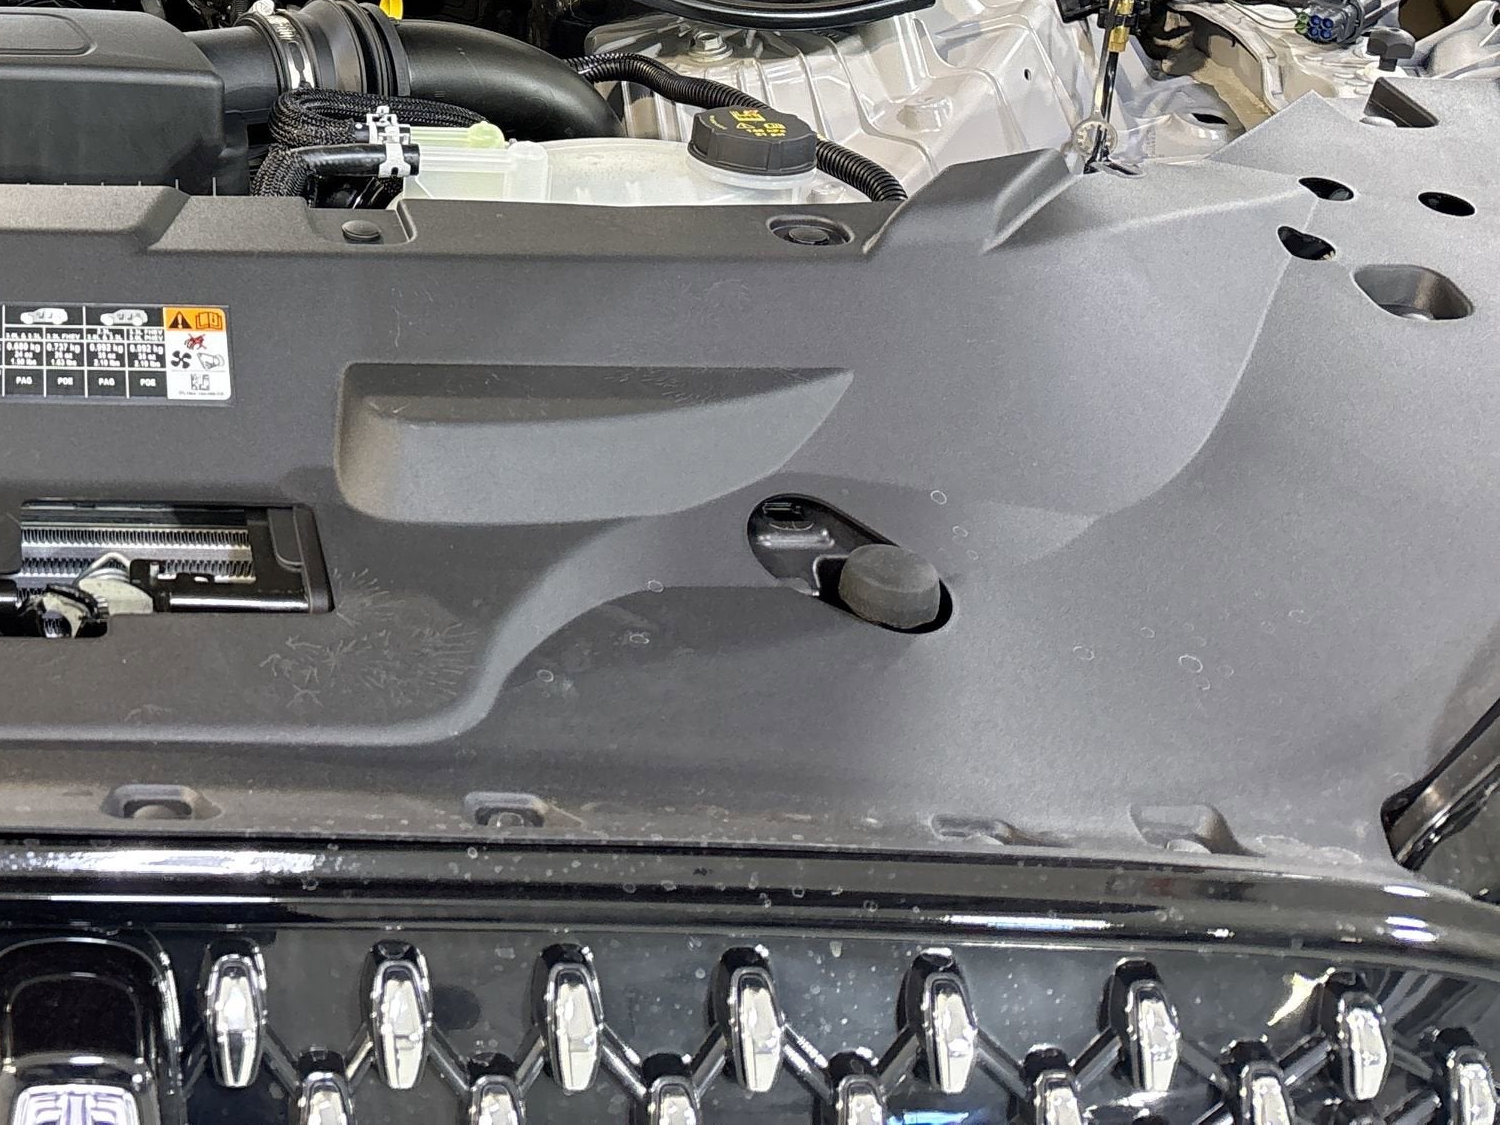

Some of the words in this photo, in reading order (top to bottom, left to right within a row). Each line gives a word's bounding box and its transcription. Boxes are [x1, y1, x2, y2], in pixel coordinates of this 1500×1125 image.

[6, 342, 28, 351] 0.680
[30, 342, 40, 353] kg
[46, 343, 68, 351] 0.737
[70, 343, 80, 353] kg
[113, 343, 123, 354] kg
[130, 344, 151, 352] 0.992
[153, 344, 163, 354] kg
[15, 376, 33, 385] PAG
[57, 377, 73, 385] POE
[98, 377, 115, 386] PAG
[139, 378, 156, 386] POE
